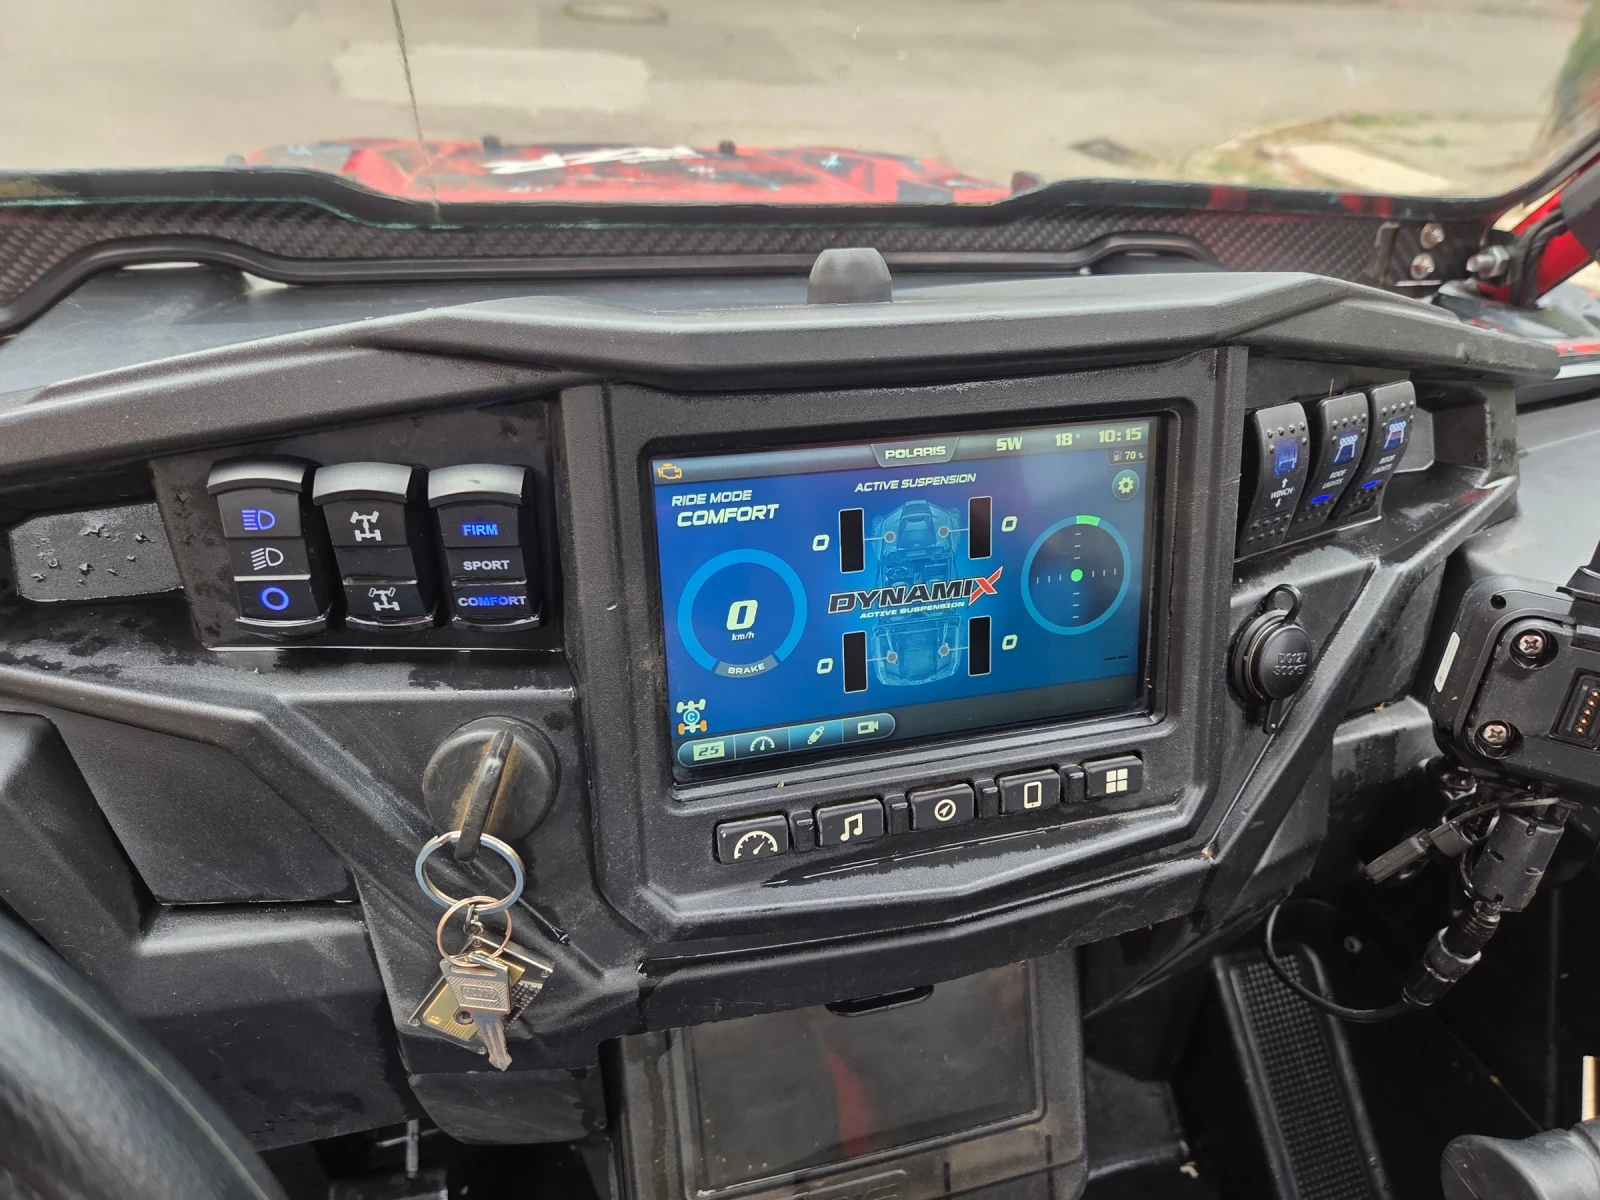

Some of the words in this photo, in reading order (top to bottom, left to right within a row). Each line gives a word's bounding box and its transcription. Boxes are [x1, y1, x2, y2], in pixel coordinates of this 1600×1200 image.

[1098, 427, 1143, 443] 10:15
[996, 436, 1023, 452] SW
[885, 446, 946, 460] POLARIS
[854, 479, 899, 493] ACTIVE
[901, 473, 977, 489] SUSPENSION
[671, 493, 707, 507] RIDE
[709, 489, 753, 504] MODE
[1270, 487, 1294, 499] WINCH
[676, 503, 780, 527] COMFORT
[462, 523, 498, 536] FIRM
[463, 560, 510, 571] SPORT
[827, 566, 1004, 615] DYNAMIX
[457, 595, 527, 607] COMFORT
[726, 599, 758, 631] 0
[859, 609, 898, 620] ACTIVE
[899, 601, 965, 615] SUSPENSION
[731, 631, 755, 642] km/h
[727, 663, 766, 676] BRAKE
[697, 745, 721, 757] 25
